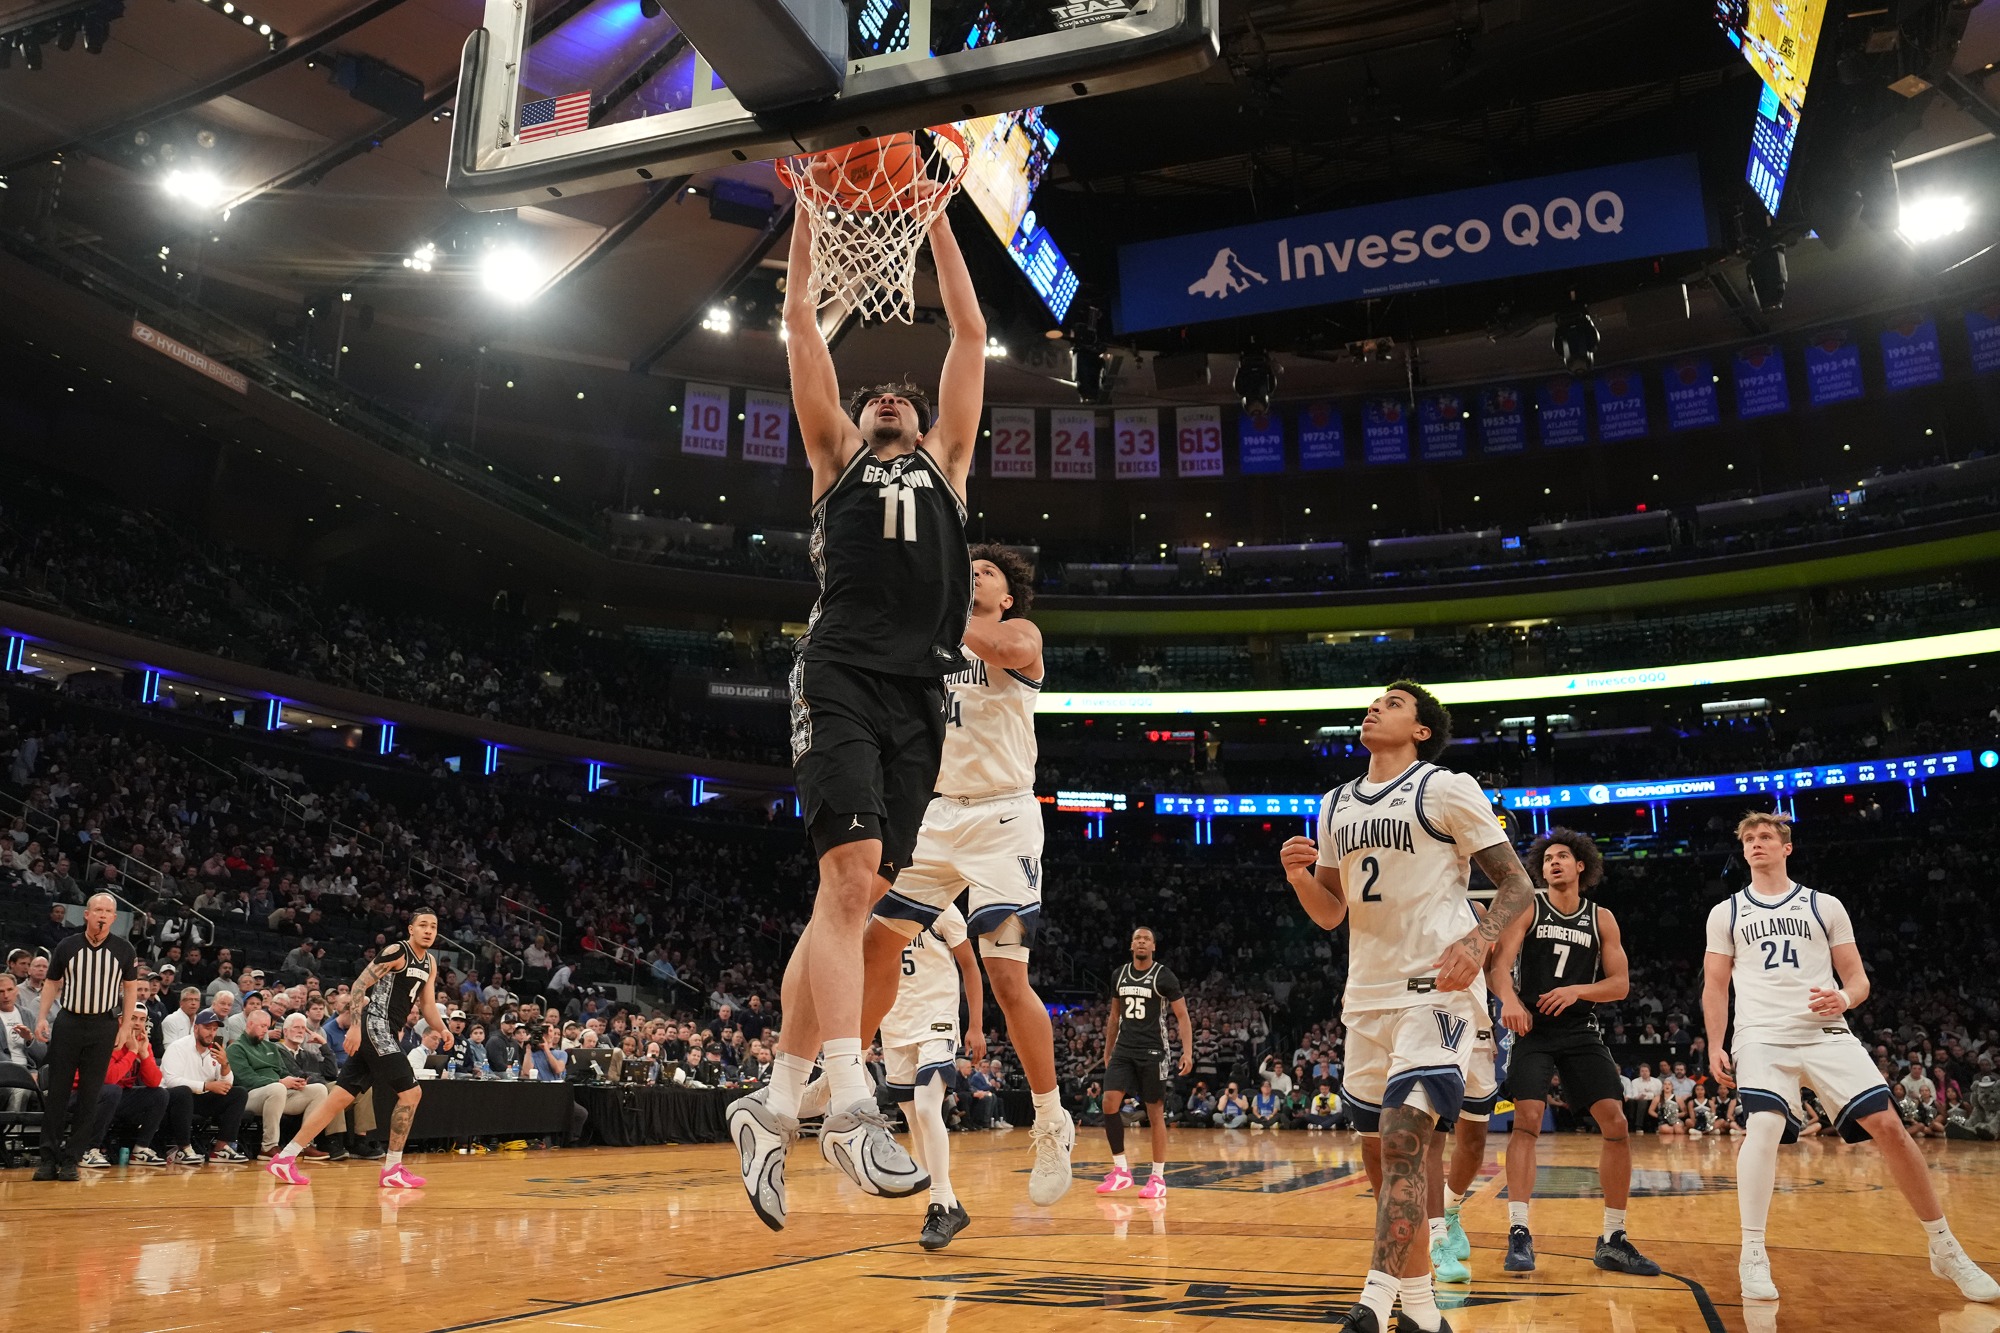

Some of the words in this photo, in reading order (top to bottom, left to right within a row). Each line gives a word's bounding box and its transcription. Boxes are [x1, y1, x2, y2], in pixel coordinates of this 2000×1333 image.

[1278, 219, 1491, 283] Invesco
[1502, 190, 1625, 247] QQQ
[1888, 341, 1935, 359] 1993-94
[157, 337, 208, 370] HYUNDAI
[208, 363, 247, 391] BRIDGE
[1811, 357, 1857, 375] 1993-94
[1738, 372, 1782, 388] 1992-93
[1891, 372, 1938, 387] CHAMPIONS
[1669, 385, 1712, 401] 1988-89
[1814, 387, 1860, 402] CHAMPIONS
[1542, 407, 1581, 420] 1970-71
[1601, 398, 1641, 412] 1971-72
[691, 404, 721, 433] 10
[753, 411, 781, 440] 12
[1482, 414, 1521, 427] 1952-53
[1366, 424, 1404, 437] 1950-51
[1424, 421, 1461, 434] 1951-52
[685, 435, 725, 451] KNICKS
[995, 429, 1031, 455] 22
[1055, 430, 1091, 456] 24
[1118, 430, 1155, 455] 33
[1179, 427, 1221, 454] 613
[1243, 435, 1280, 446] 1969-70
[1302, 431, 1339, 442] 1972-73
[745, 442, 785, 459] KNICKS
[994, 460, 1033, 473] KNICKS
[1054, 461, 1093, 474] KNICKS
[1118, 460, 1158, 473] KNICKS
[1181, 458, 1221, 472] KNICKS
[878, 483, 918, 542] 11
[1587, 675, 1636, 687] Invesco
[1638, 671, 1667, 684] QQQ
[711, 685, 735, 695] BUD
[736, 687, 770, 698] LIGHT
[1739, 783, 1747, 793] 0
[1760, 782, 1766, 791] 1
[1796, 778, 1812, 788] 0.0
[1859, 772, 1875, 782] 0.0
[1890, 770, 1896, 779] 1
[1908, 768, 1916, 777] 0
[1927, 766, 1935, 775] 0
[1057, 791, 1113, 801] WASHINGTON
[1560, 789, 1571, 802] 2
[1615, 781, 1715, 798] GEORGETOWN
[1335, 818, 1416, 861] VILLANOVA
[1361, 856, 1382, 903] 2
[1536, 924, 1592, 949] GEORGETOWN
[1741, 917, 1812, 946] VILLANOVA
[901, 949, 916, 976] 5
[1553, 943, 1571, 979] 7
[1760, 939, 1800, 970] 24
[1125, 996, 1146, 1020] 25
[1432, 1010, 1469, 1054] V
